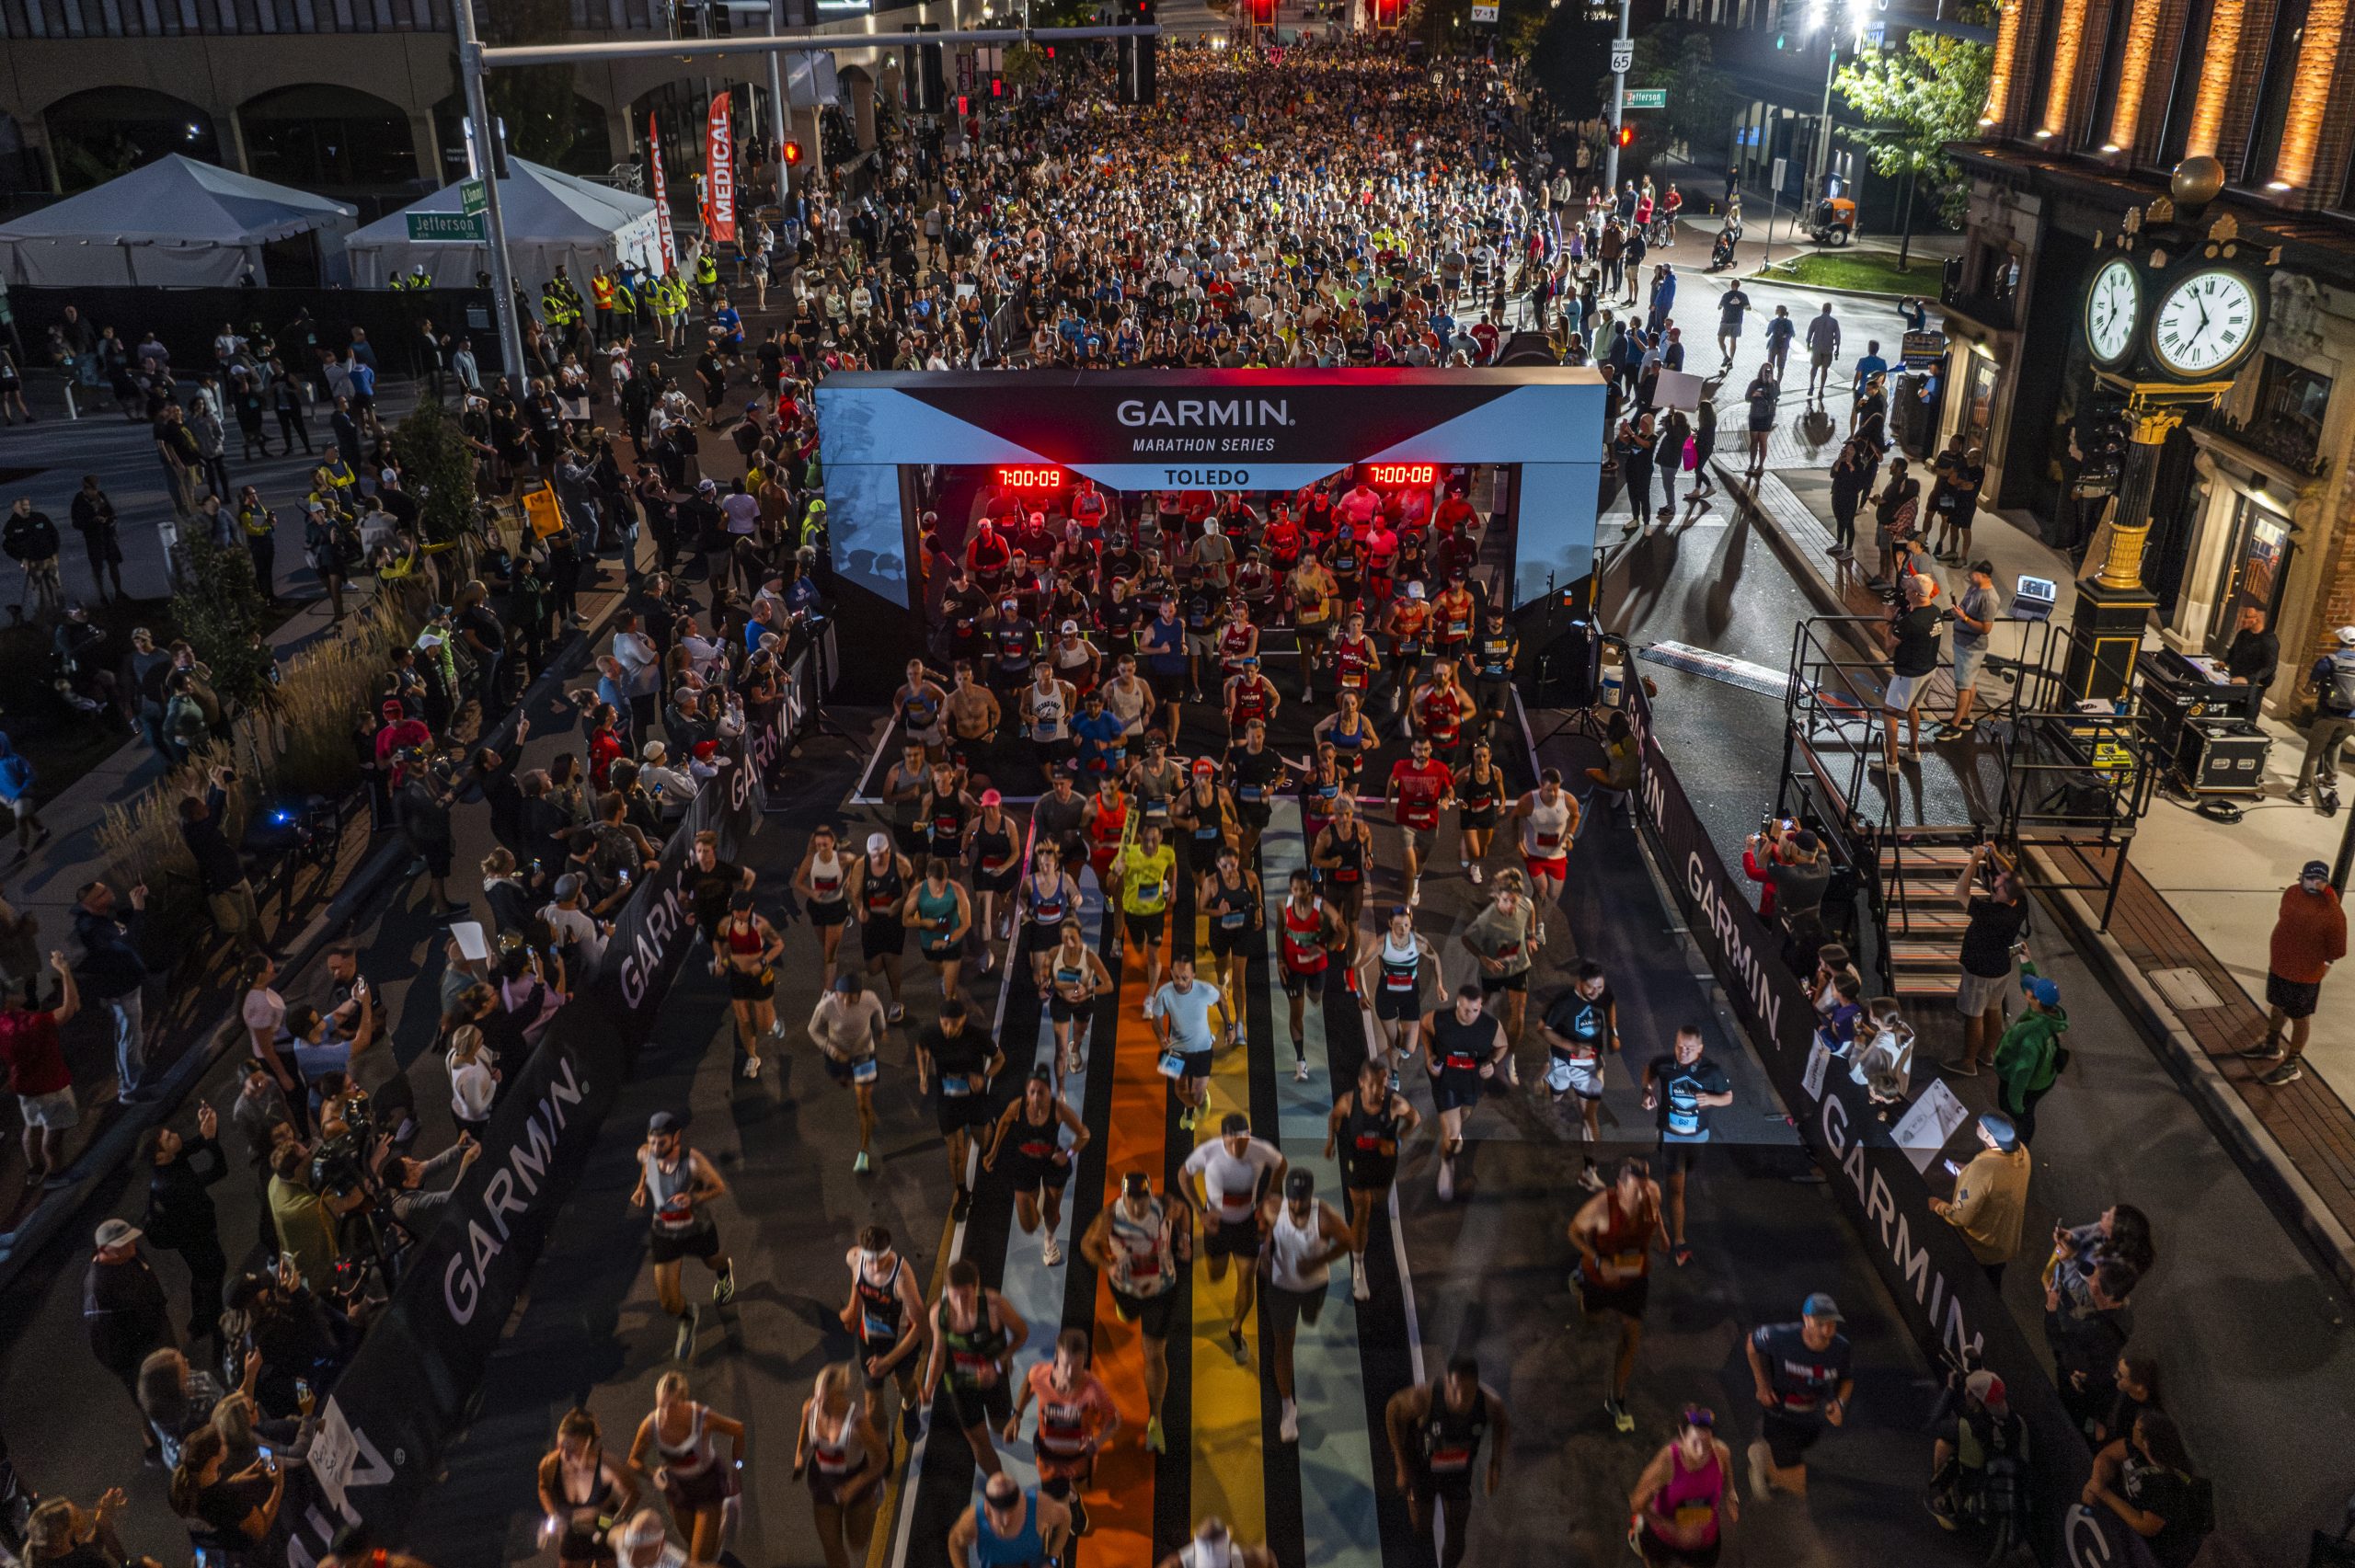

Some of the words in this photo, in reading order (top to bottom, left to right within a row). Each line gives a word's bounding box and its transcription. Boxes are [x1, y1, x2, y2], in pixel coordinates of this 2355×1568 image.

[1613, 41, 1633, 50] NORTH
[1614, 56, 1629, 68] 65
[1627, 93, 1661, 101] Jefferson
[712, 110, 733, 223] MEDICAL
[416, 216, 475, 231] Jefferson
[1117, 399, 1288, 427] GARMIN
[1132, 438, 1215, 452] MARATHON
[1221, 438, 1275, 452] SERIES
[1165, 469, 1249, 486] TOLEDO
[1688, 851, 1780, 1042] GARMIN
[444, 1057, 582, 1326] GARMIN
